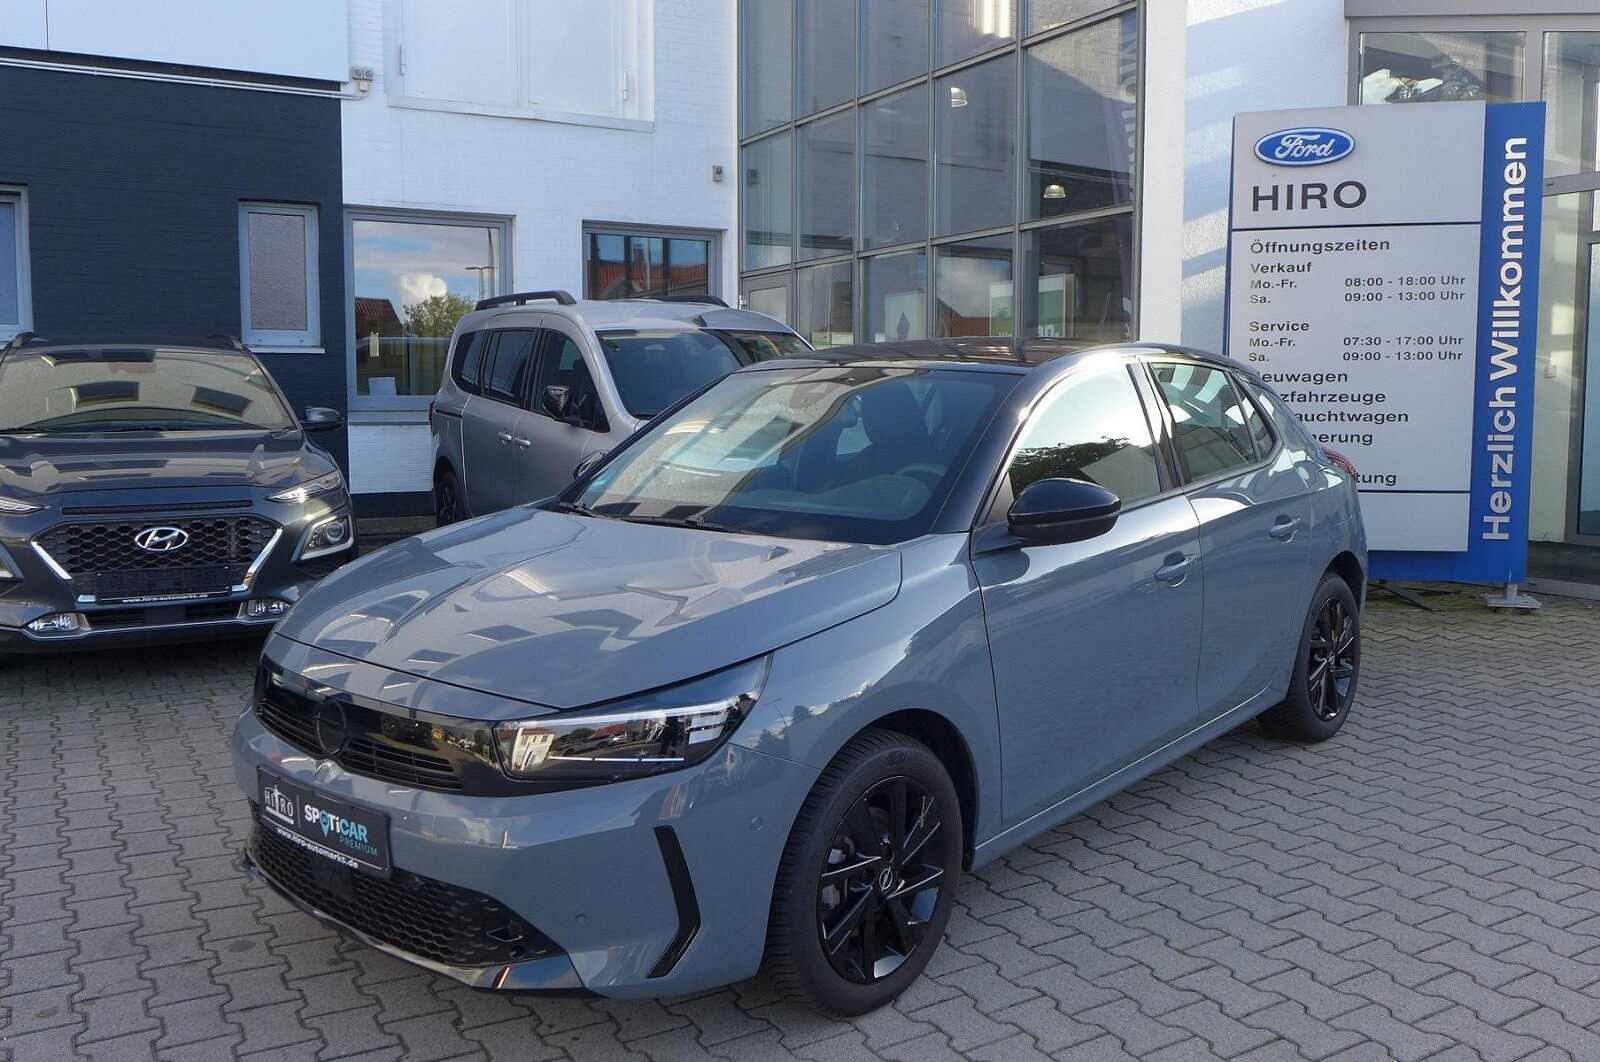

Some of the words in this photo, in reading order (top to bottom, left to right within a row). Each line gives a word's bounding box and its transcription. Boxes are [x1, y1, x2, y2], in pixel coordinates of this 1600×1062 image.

[1252, 180, 1367, 213] HIRO
[1250, 238, 1390, 256] Öffnungszeiten
[1489, 137, 1527, 382] Willkommen
[1250, 261, 1312, 274] Verkauf
[1250, 278, 1297, 290] Mo.-Fr.
[1344, 276, 1384, 287] 08:00
[1397, 275, 1436, 286] 18:00
[1440, 275, 1467, 286] Uhr
[1250, 294, 1271, 304] Sa.
[1344, 292, 1383, 302] 09:00
[1397, 291, 1436, 301] 13:00
[1440, 290, 1466, 301] Uhr
[1249, 320, 1310, 332] Service
[1249, 337, 1296, 347] Mo.-Fr.
[1343, 336, 1382, 346] 07:30
[1396, 335, 1434, 346] 17:00
[1438, 335, 1464, 346] Uhr
[1248, 352, 1270, 362] Sa.
[1342, 351, 1382, 361] 09:00
[1395, 351, 1434, 361] 13:00
[1438, 350, 1464, 361] Uhr
[1258, 371, 1348, 385] euwagen
[1280, 390, 1386, 404] zfahrzeuge
[1295, 411, 1409, 425] auchtwagen
[1312, 433, 1373, 446] erung
[1482, 386, 1517, 541] Herzlich
[1356, 472, 1397, 487] tung
[263, 787, 295, 818] HIRO
[275, 826, 360, 870] www.hiro-automarkt.de
[339, 835, 379, 858] PREMIUM
